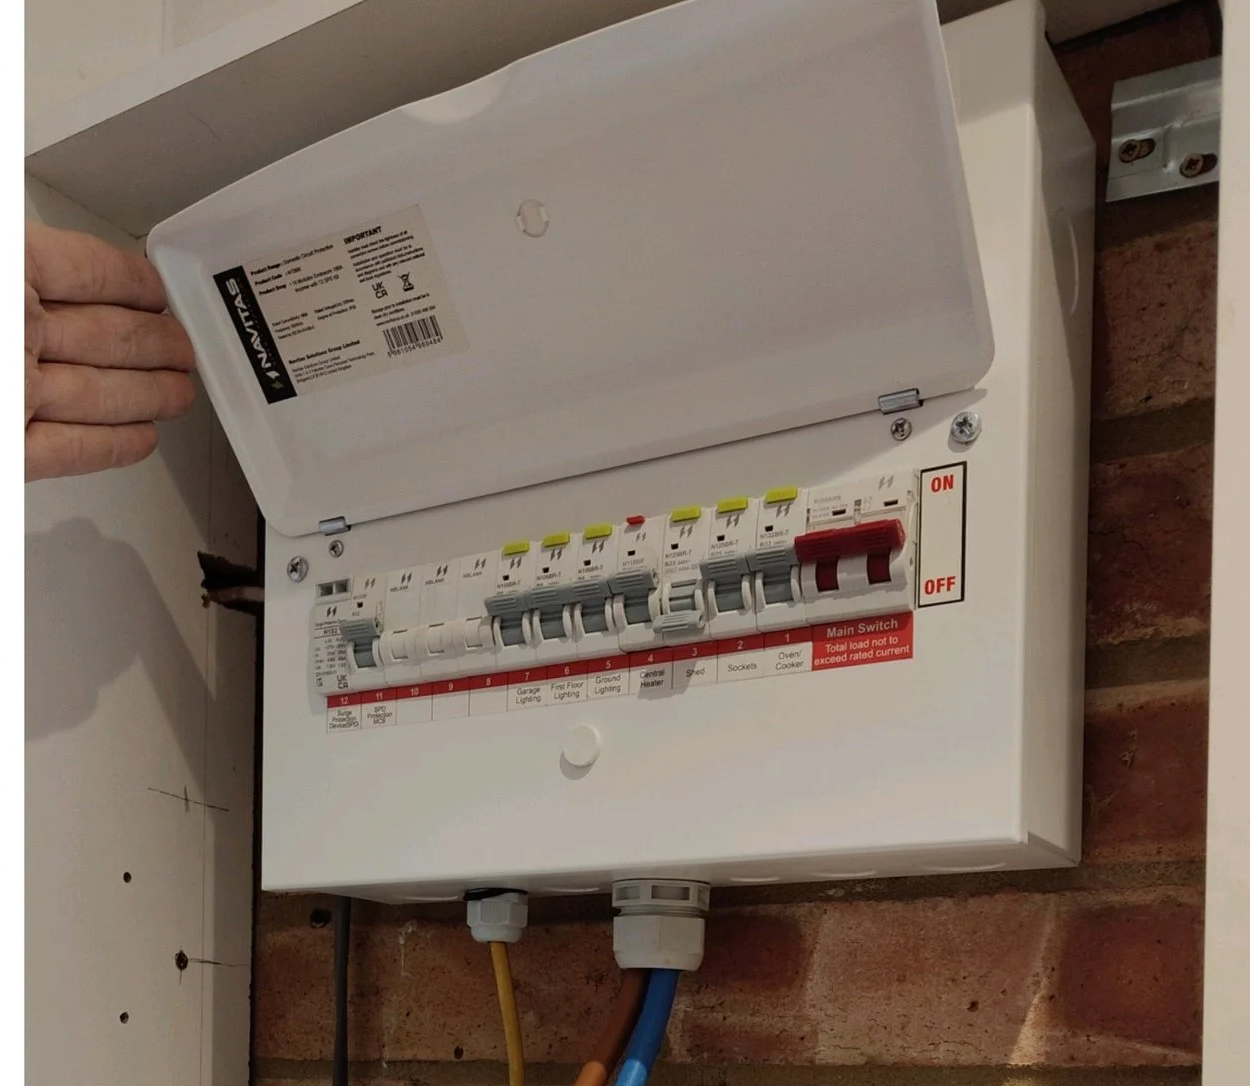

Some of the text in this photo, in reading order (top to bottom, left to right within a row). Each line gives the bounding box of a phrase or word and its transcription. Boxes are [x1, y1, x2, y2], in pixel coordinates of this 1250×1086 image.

[226, 278, 271, 368] NAVITAS
[930, 475, 954, 492] ON
[924, 575, 955, 595] OFF
[826, 618, 898, 638] Main Switch
[825, 636, 899, 653] Total load not to
[777, 650, 802, 660] Oven/
[814, 644, 909, 667] exceed rated current
[727, 662, 757, 672] Sockets
[775, 661, 804, 670] Cooker
[640, 668, 665, 679] Central
[685, 667, 705, 679] Shed
[595, 674, 621, 684] Ground
[640, 679, 664, 688] Heater
[516, 687, 540, 695] Garage
[550, 681, 584, 691] First Floor
[594, 684, 621, 695] Lighting
[515, 695, 541, 705] Lighting
[553, 690, 580, 701] Lighting
